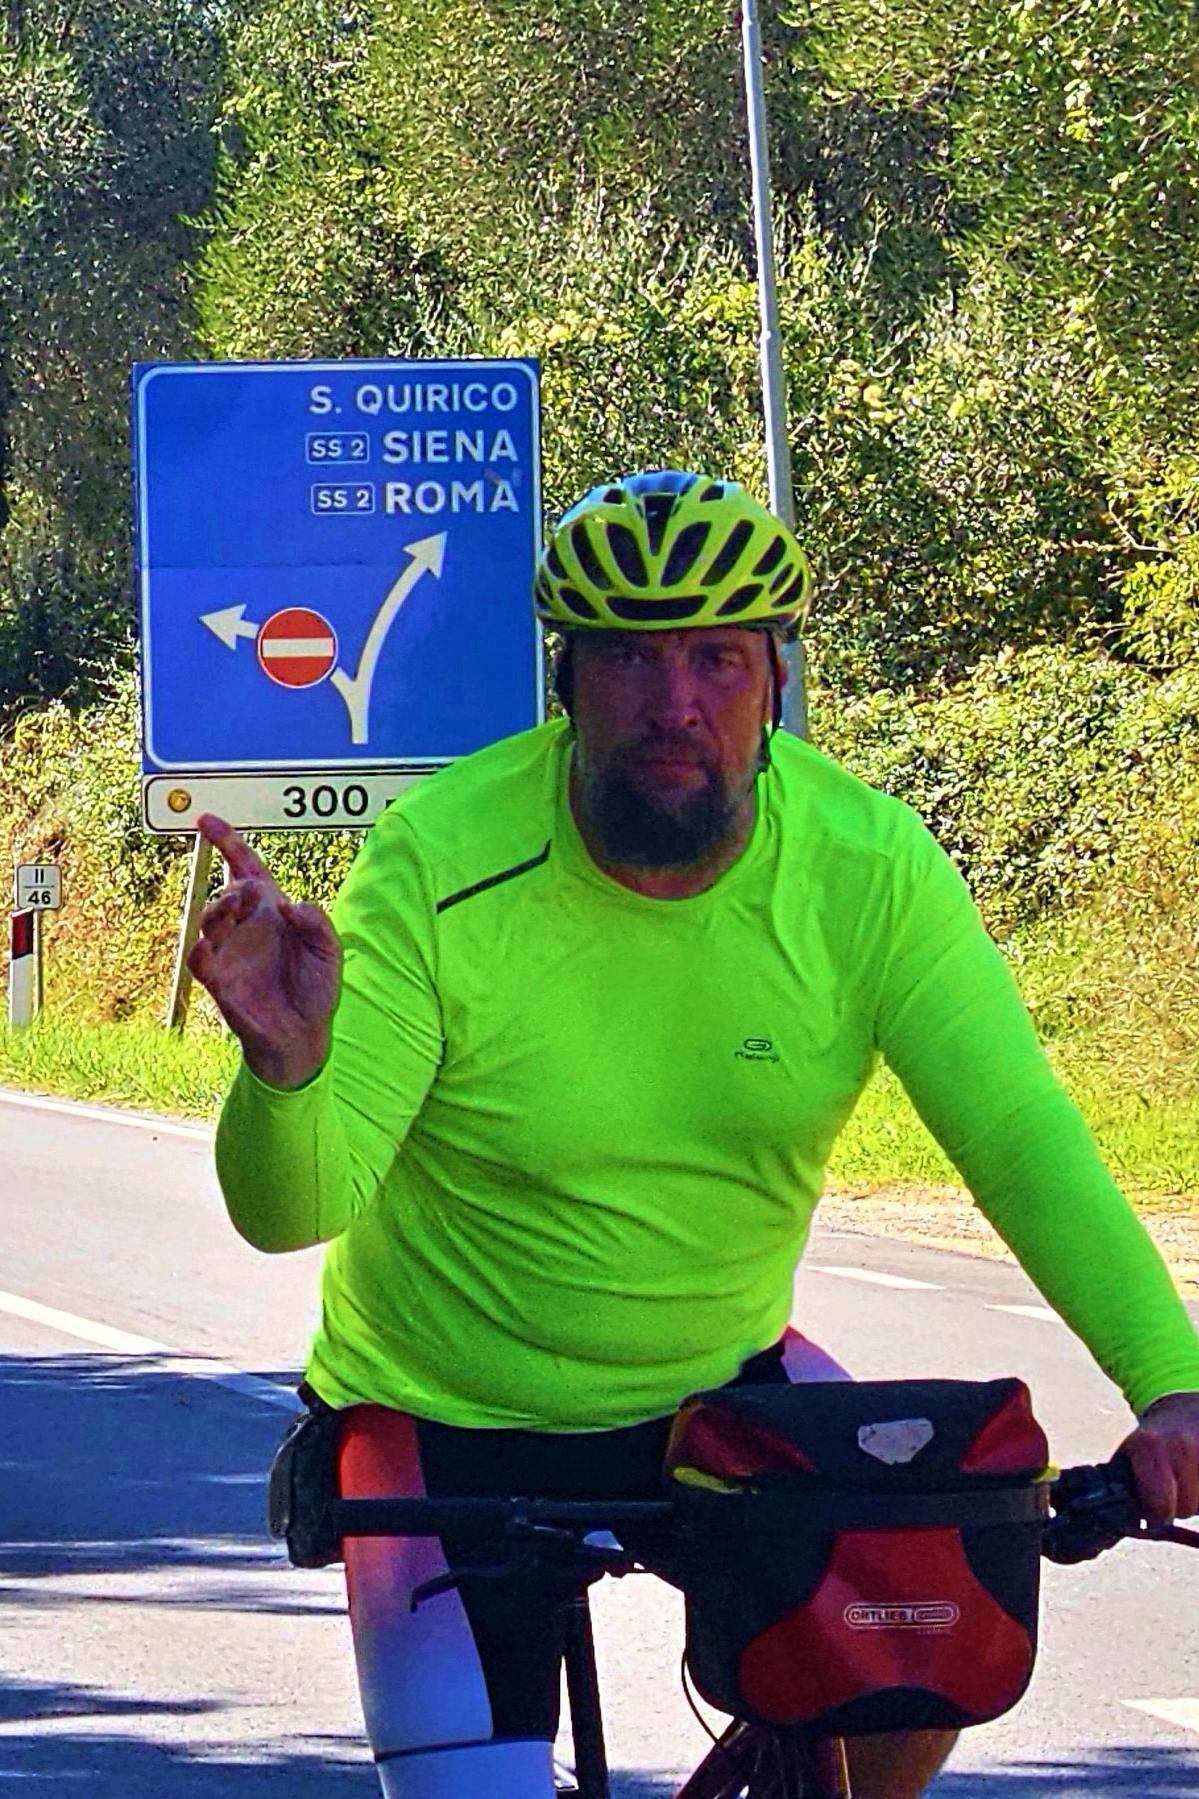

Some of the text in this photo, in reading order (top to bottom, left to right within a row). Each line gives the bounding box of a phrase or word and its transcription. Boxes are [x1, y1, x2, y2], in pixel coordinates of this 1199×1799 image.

[309, 382, 518, 415] S. QUIRICO
[311, 439, 365, 458] SS 2
[382, 430, 519, 464] SIENA
[317, 490, 371, 508] SS 2
[385, 481, 520, 513] ROMA
[282, 784, 369, 818] 300
[28, 890, 51, 905] 46
